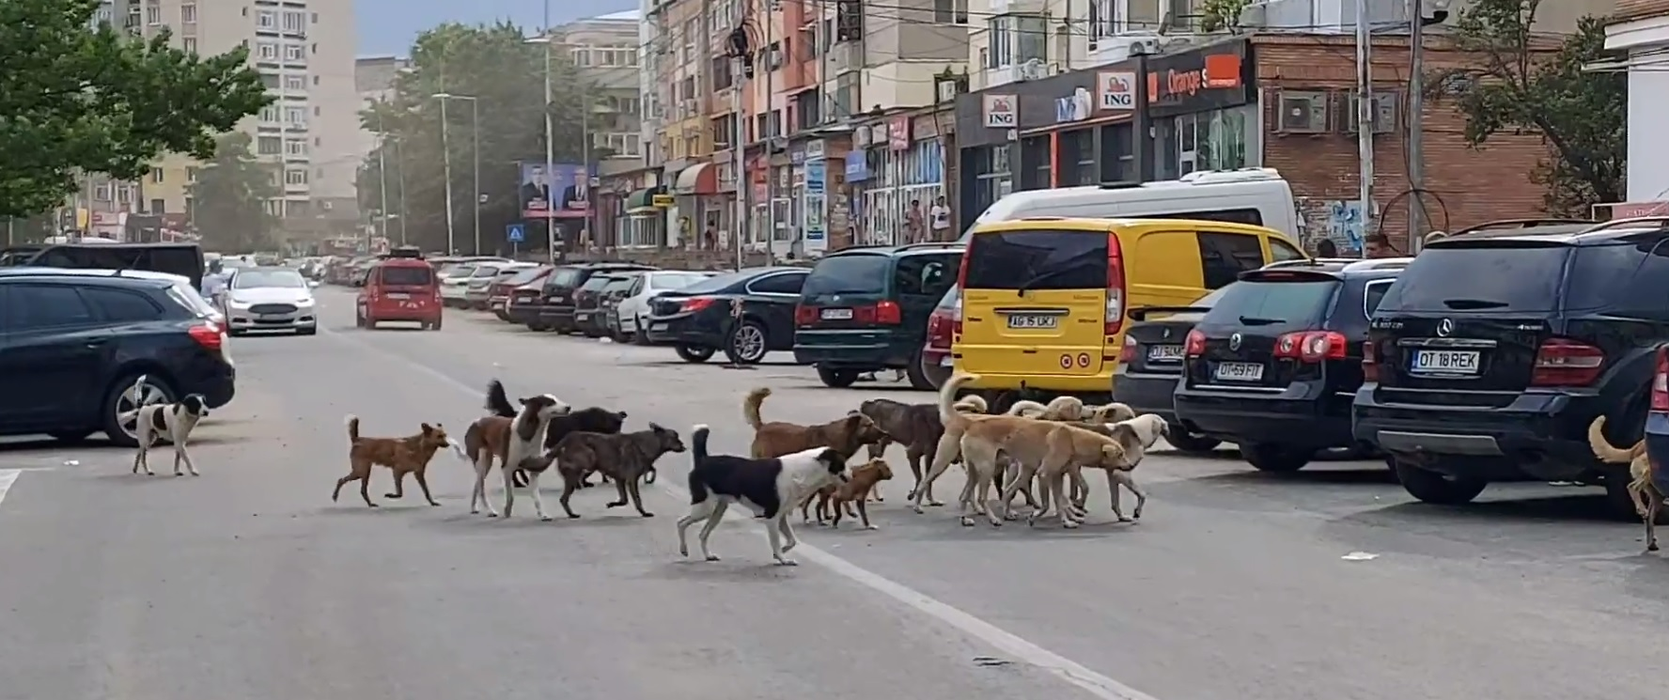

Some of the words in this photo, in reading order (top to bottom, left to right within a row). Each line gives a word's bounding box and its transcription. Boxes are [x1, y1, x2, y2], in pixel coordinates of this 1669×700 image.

[1168, 68, 1200, 96] Orange
[1104, 94, 1131, 105] ING
[990, 114, 1013, 124] ING
[1420, 351, 1435, 367] OT
[1438, 352, 1449, 367] 18
[1450, 353, 1477, 368] REK
[1245, 364, 1261, 377] FIT
